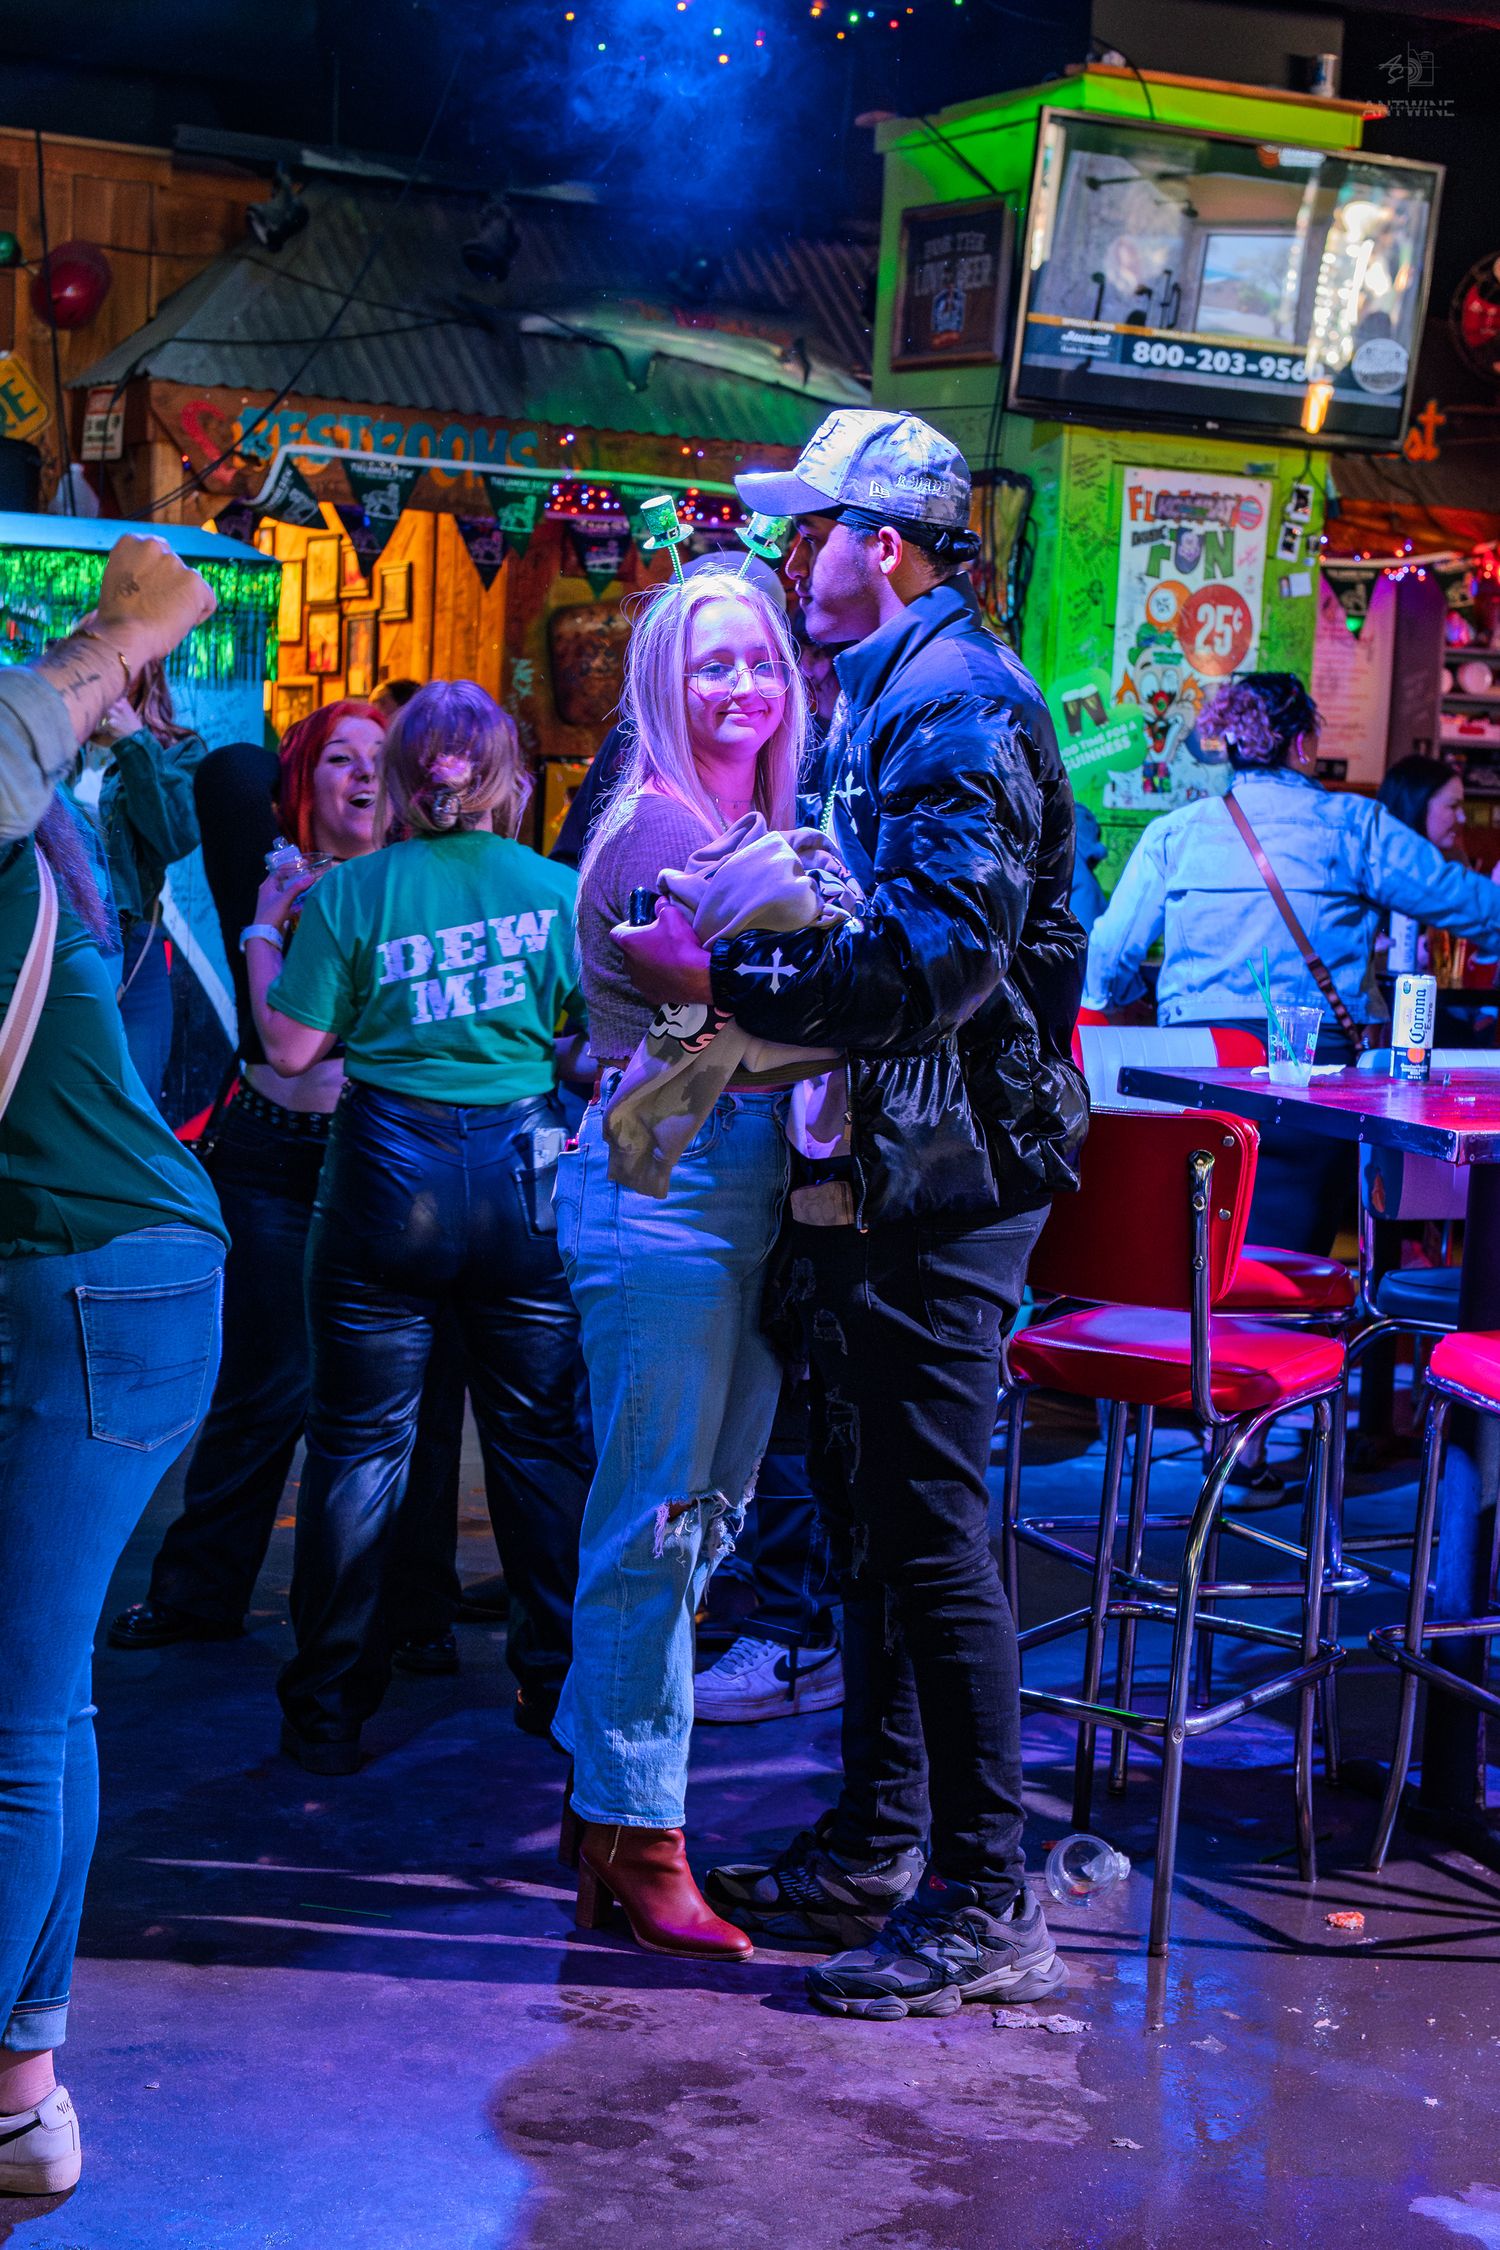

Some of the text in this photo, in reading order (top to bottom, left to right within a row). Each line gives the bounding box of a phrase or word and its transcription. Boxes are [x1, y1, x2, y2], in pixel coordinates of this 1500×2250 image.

[231, 406, 538, 478] RESTROOMS
[1194, 602, 1243, 658] 25¢
[1106, 723, 1128, 740] FOR
[1128, 720, 1137, 731] A
[376, 909, 559, 985] DEW
[411, 960, 526, 1015] ME
[1408, 988, 1427, 1045] Corona
[1424, 1002, 1434, 1031] Extra
